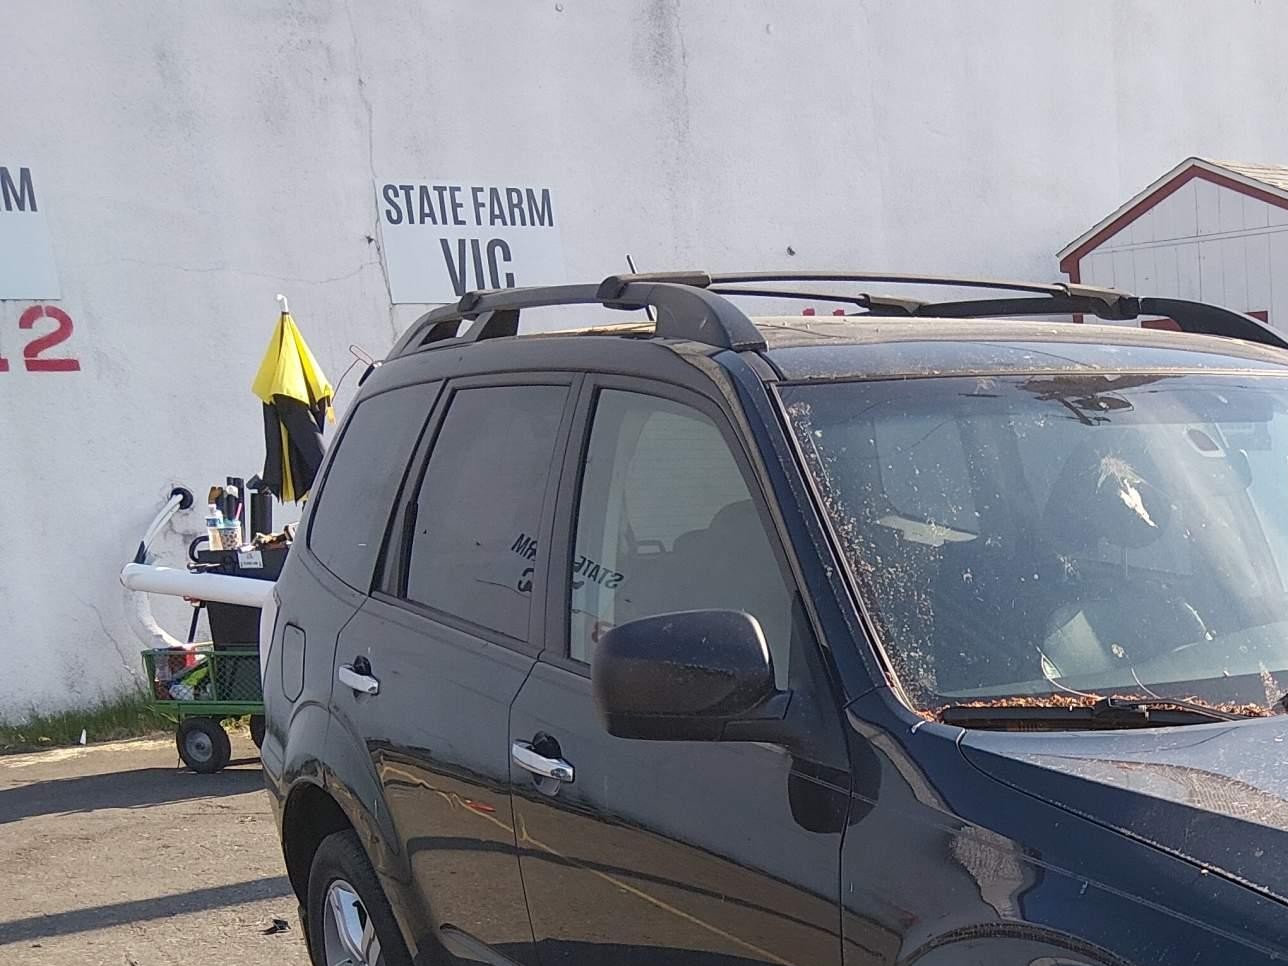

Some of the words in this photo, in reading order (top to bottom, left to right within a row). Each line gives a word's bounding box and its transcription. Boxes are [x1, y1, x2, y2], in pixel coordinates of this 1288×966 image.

[382, 184, 466, 225] STATE
[471, 186, 554, 227] FARM
[440, 238, 515, 296] VIC
[0, 305, 80, 371] 2
